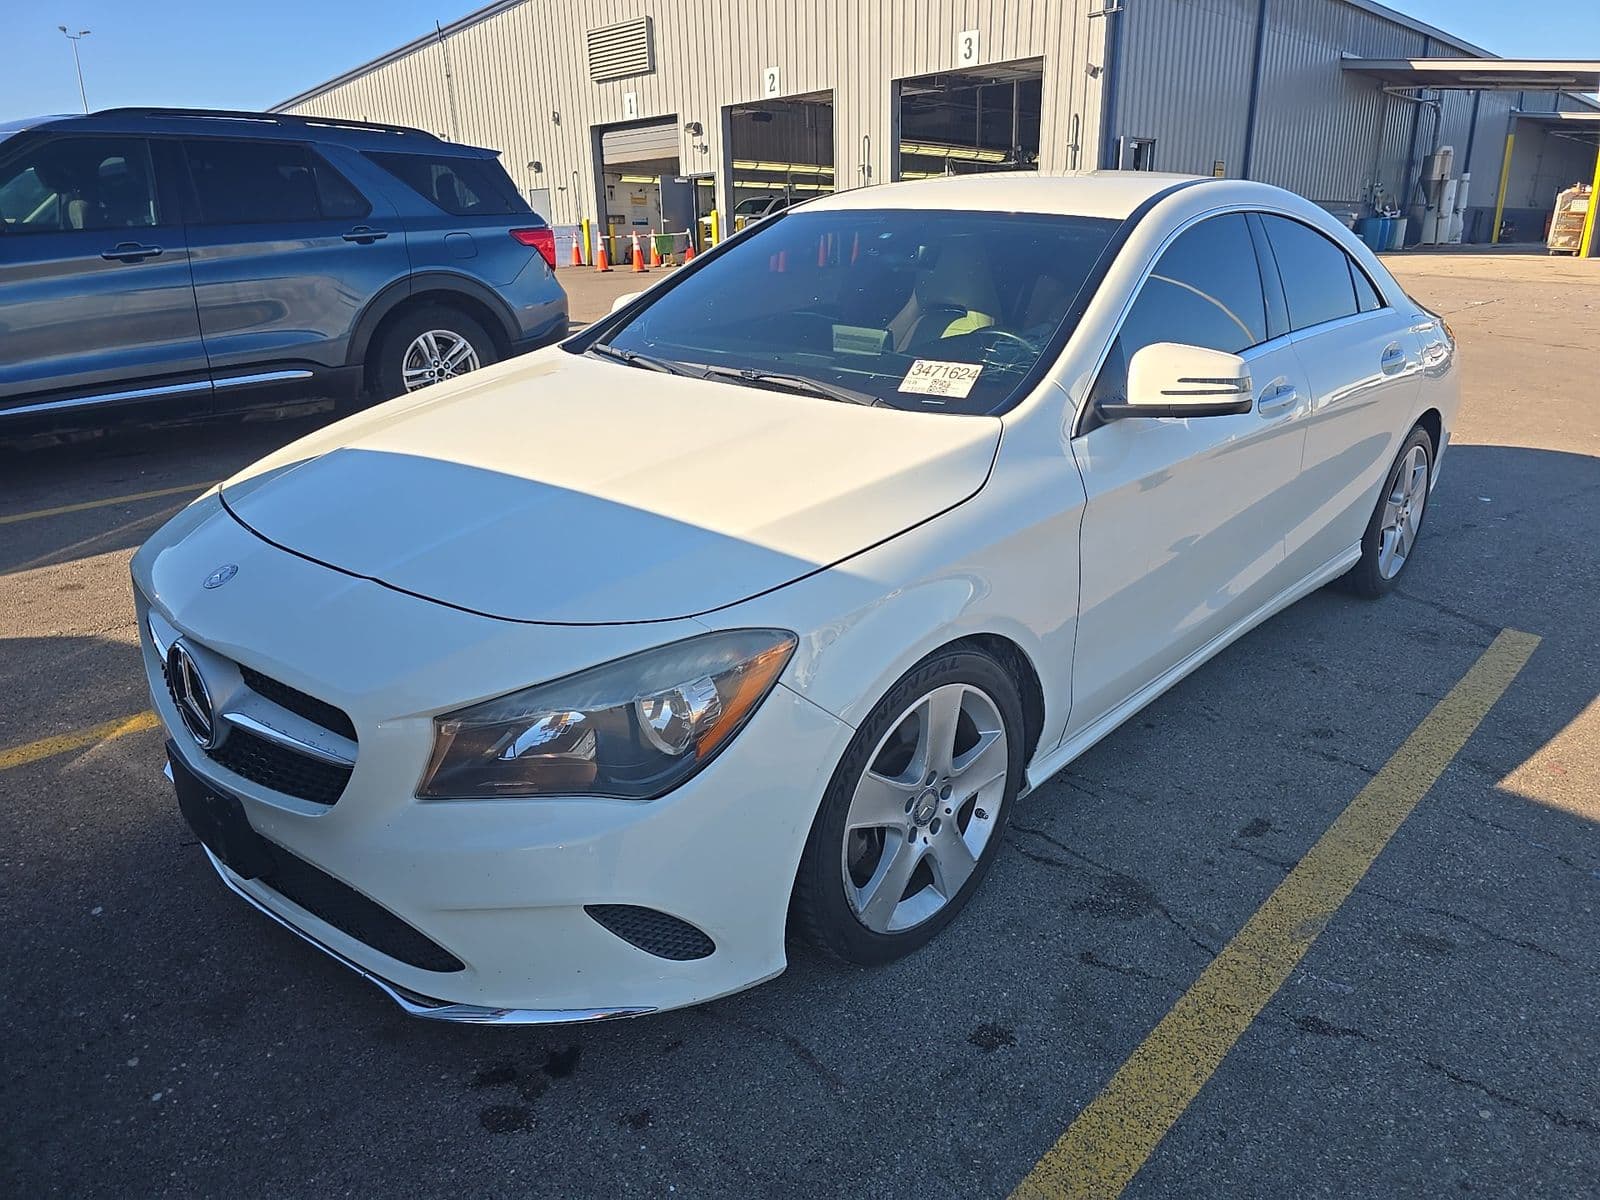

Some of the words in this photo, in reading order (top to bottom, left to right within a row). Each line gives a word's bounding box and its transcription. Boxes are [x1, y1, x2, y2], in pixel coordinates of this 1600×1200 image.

[964, 37, 973, 60] 3
[768, 73, 776, 92] 2
[911, 363, 979, 381] 3471624
